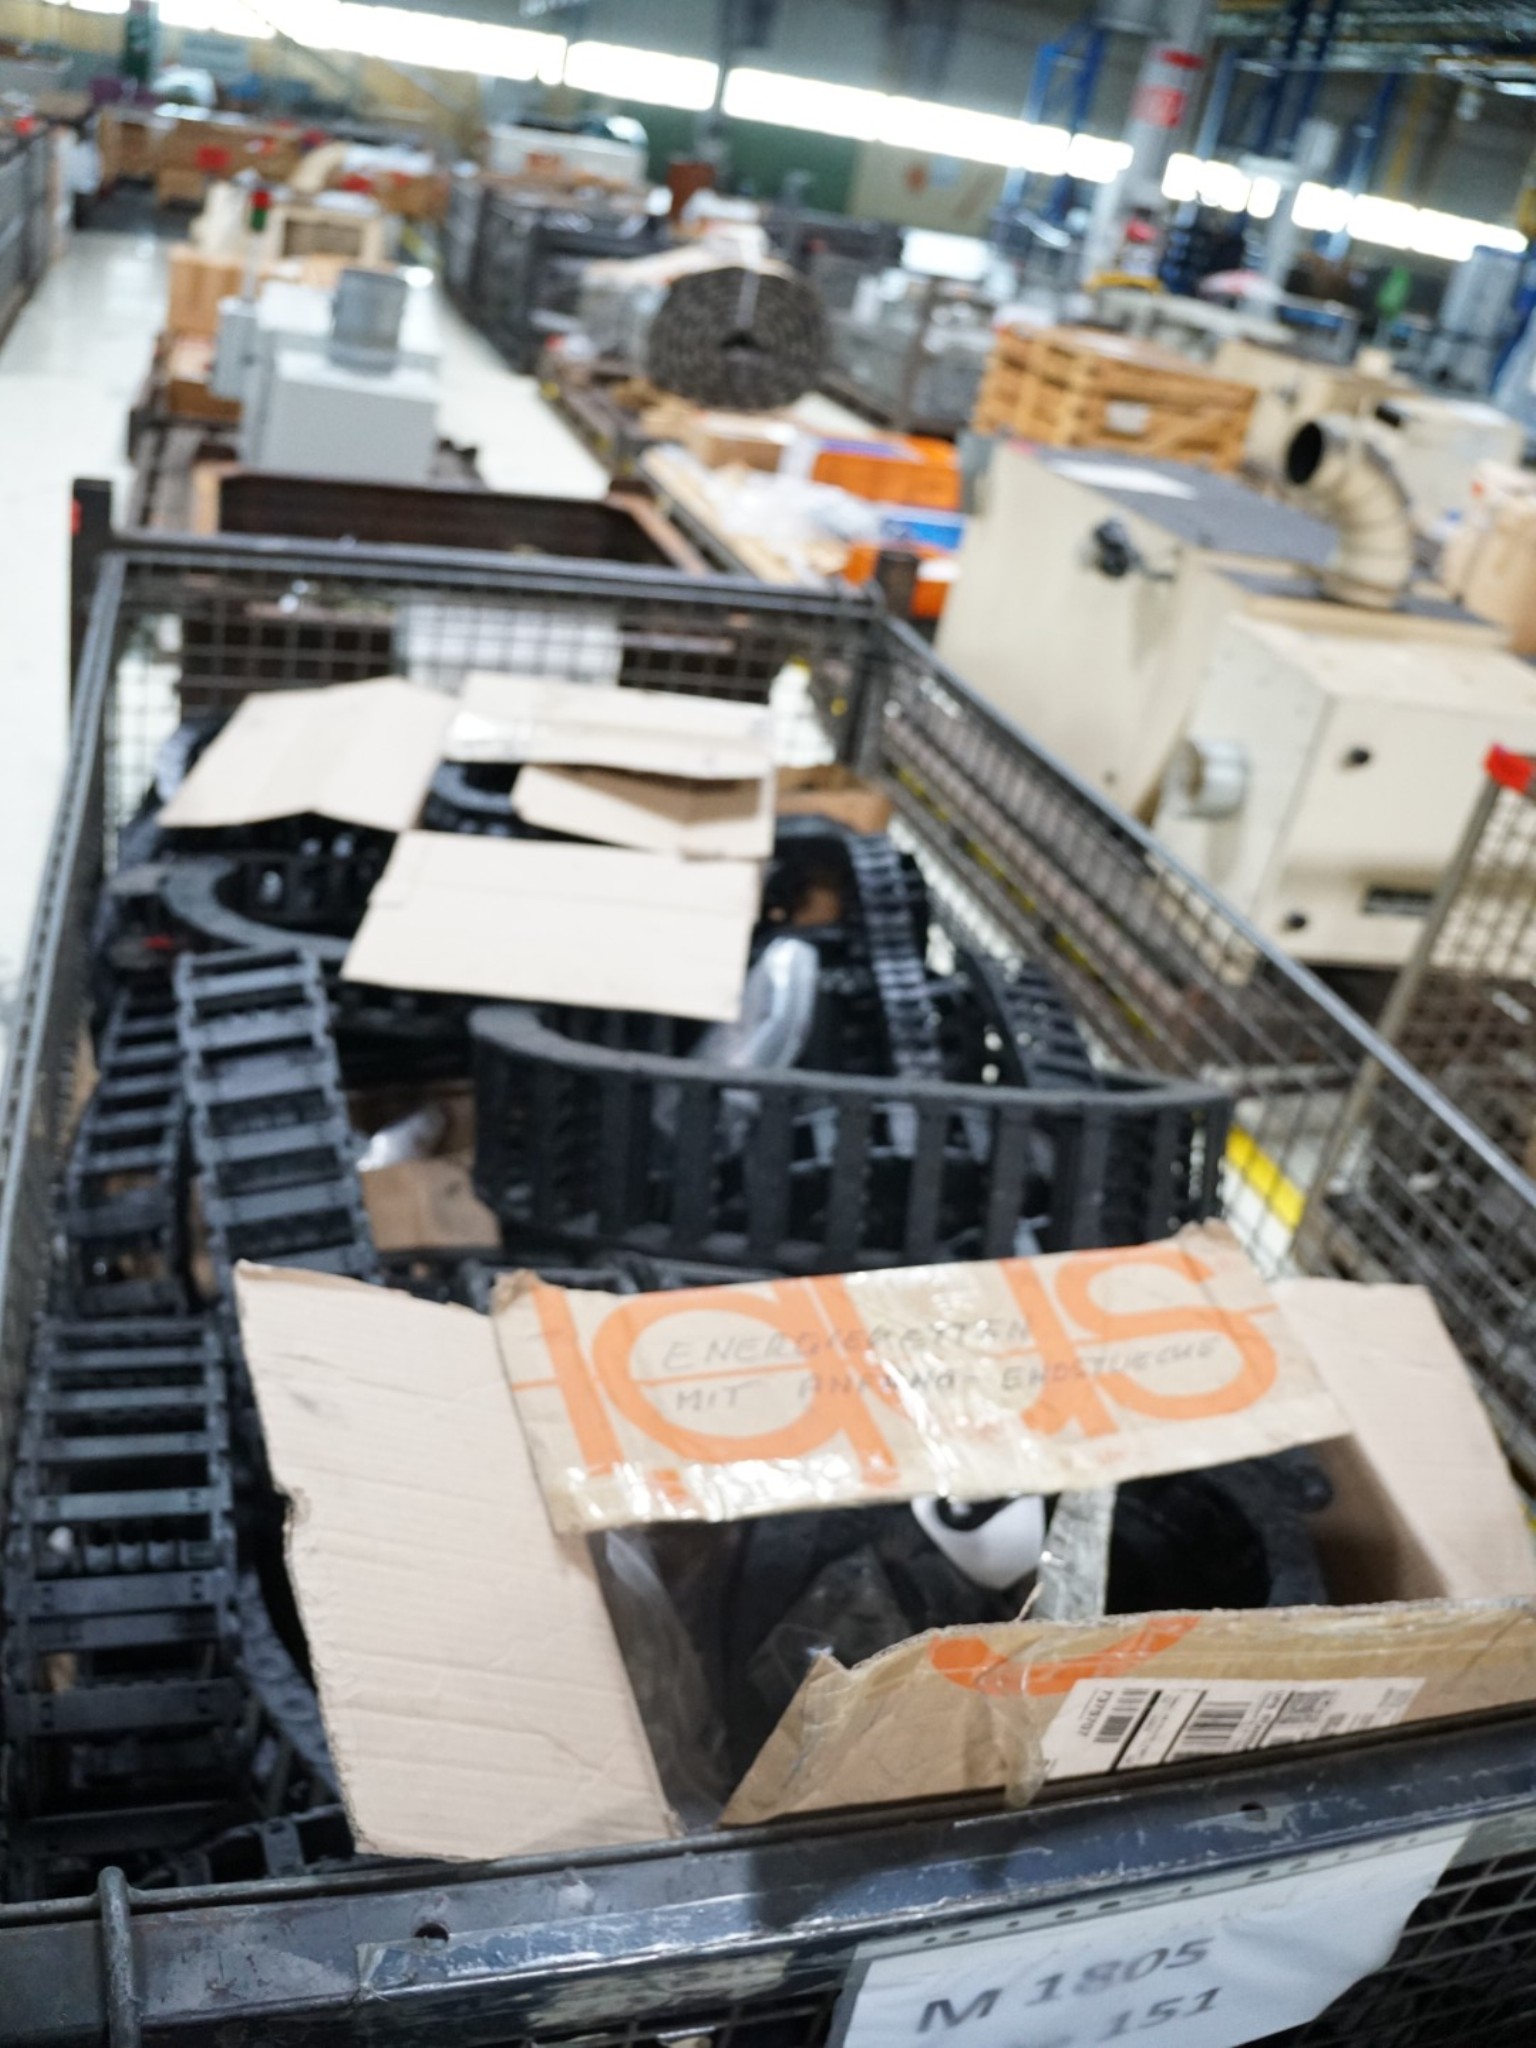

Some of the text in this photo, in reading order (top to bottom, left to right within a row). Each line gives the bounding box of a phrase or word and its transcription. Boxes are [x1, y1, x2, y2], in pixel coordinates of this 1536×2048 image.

[675, 1380, 768, 1412] MIT
[916, 1936, 1215, 2034] M 1805
[1097, 1986, 1218, 2042] 151
